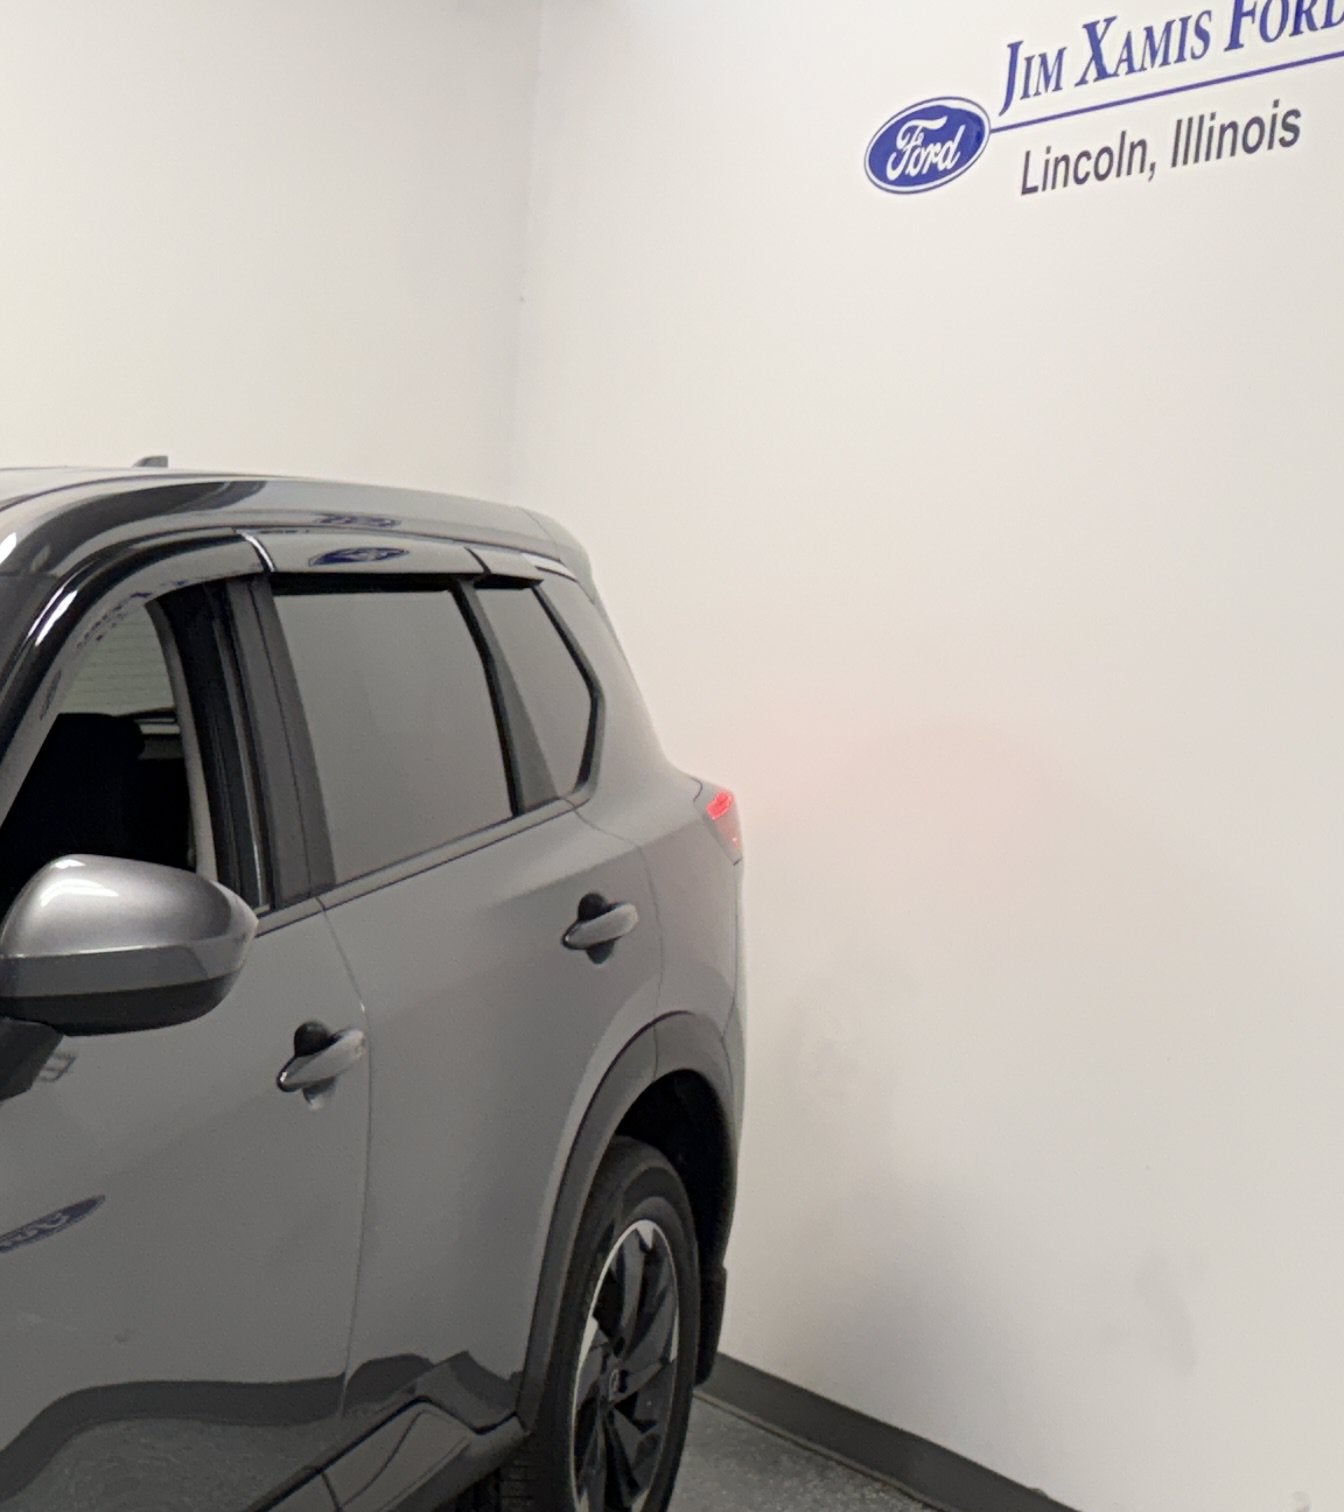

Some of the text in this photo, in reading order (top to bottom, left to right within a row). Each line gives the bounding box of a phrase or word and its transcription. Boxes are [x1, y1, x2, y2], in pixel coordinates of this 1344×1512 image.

[998, 39, 1069, 117] JIM
[1074, 9, 1214, 87] XAMIS
[886, 115, 966, 181] Ford
[1020, 98, 1302, 196] Lincoln, Illinois
